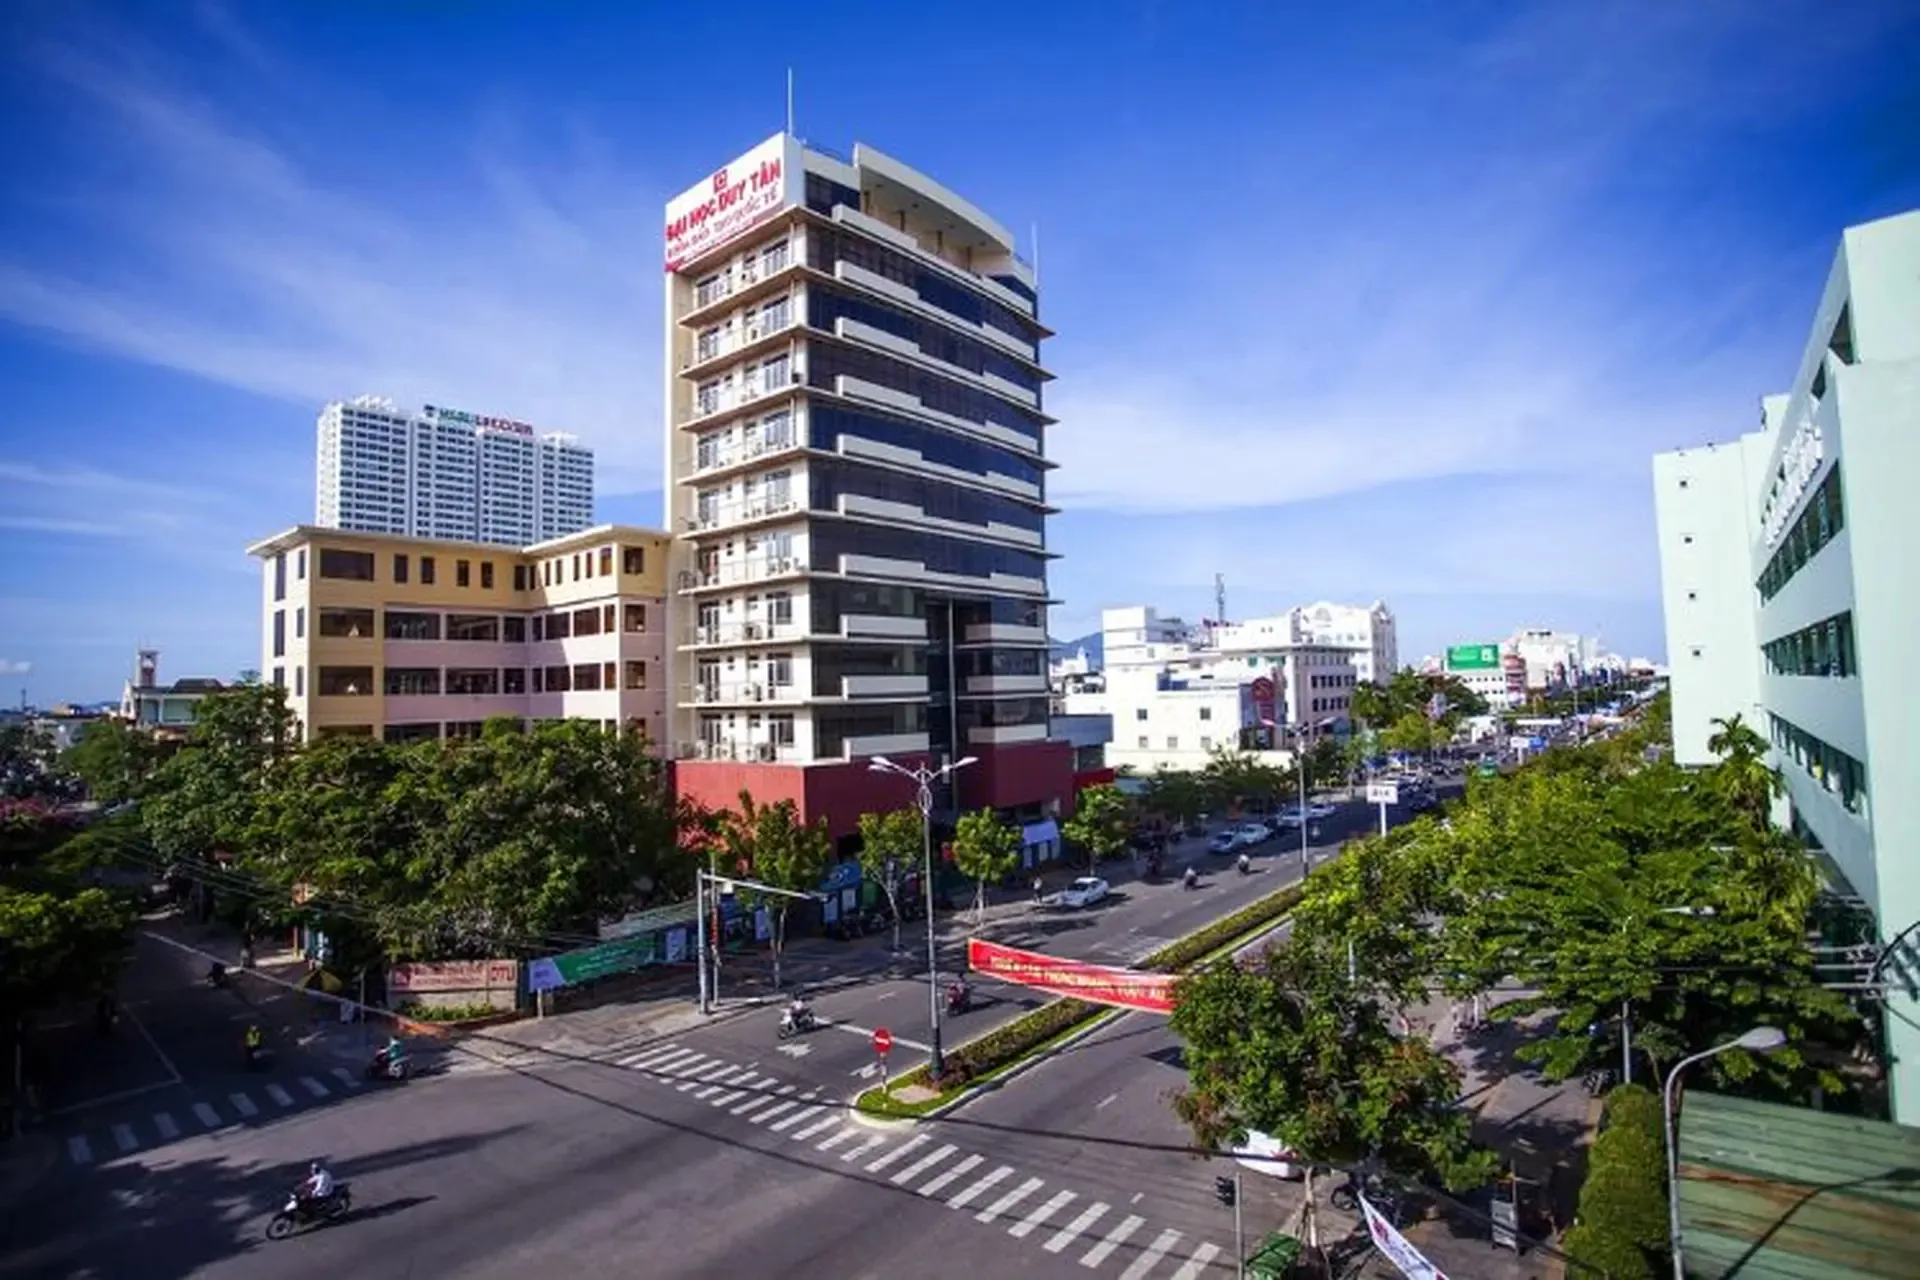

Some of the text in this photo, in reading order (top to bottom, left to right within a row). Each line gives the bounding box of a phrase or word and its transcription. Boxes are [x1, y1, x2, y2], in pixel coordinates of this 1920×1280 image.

[689, 197, 716, 228] HỌC
[718, 180, 746, 212] DUY
[750, 158, 781, 192] TÂN
